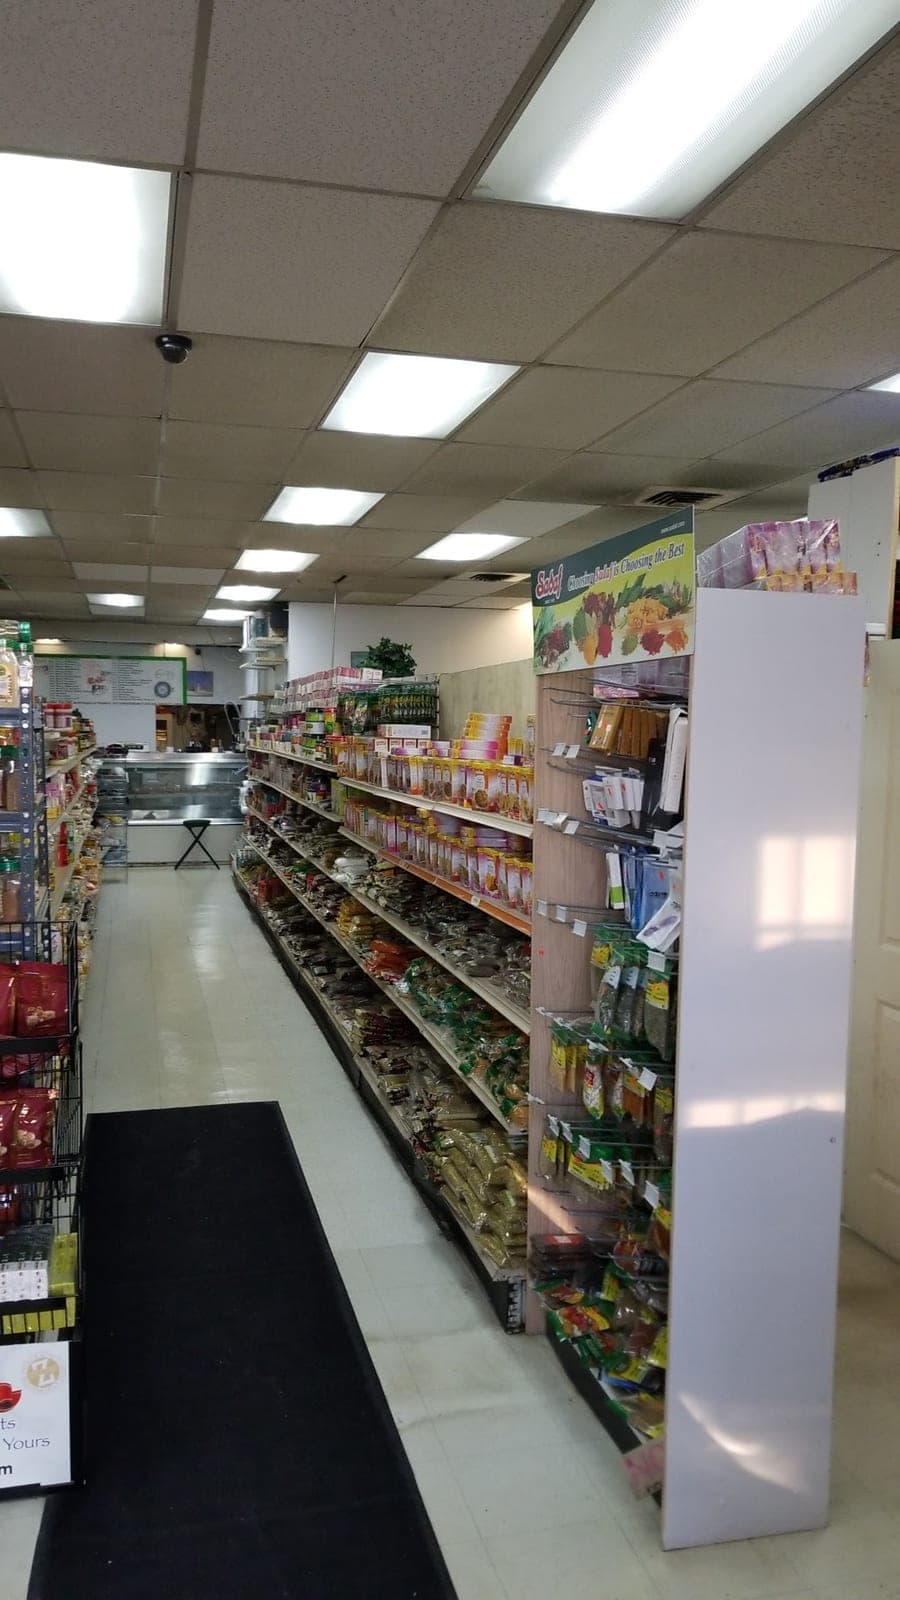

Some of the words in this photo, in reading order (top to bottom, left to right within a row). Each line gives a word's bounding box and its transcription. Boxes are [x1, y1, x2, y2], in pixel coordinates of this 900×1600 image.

[535, 563, 564, 600] Sadaf
[567, 571, 595, 592] Choosing
[621, 553, 653, 572] Choosing
[654, 548, 667, 563] the
[668, 542, 685, 558] Best
[3, 1437, 51, 1450] Yours
